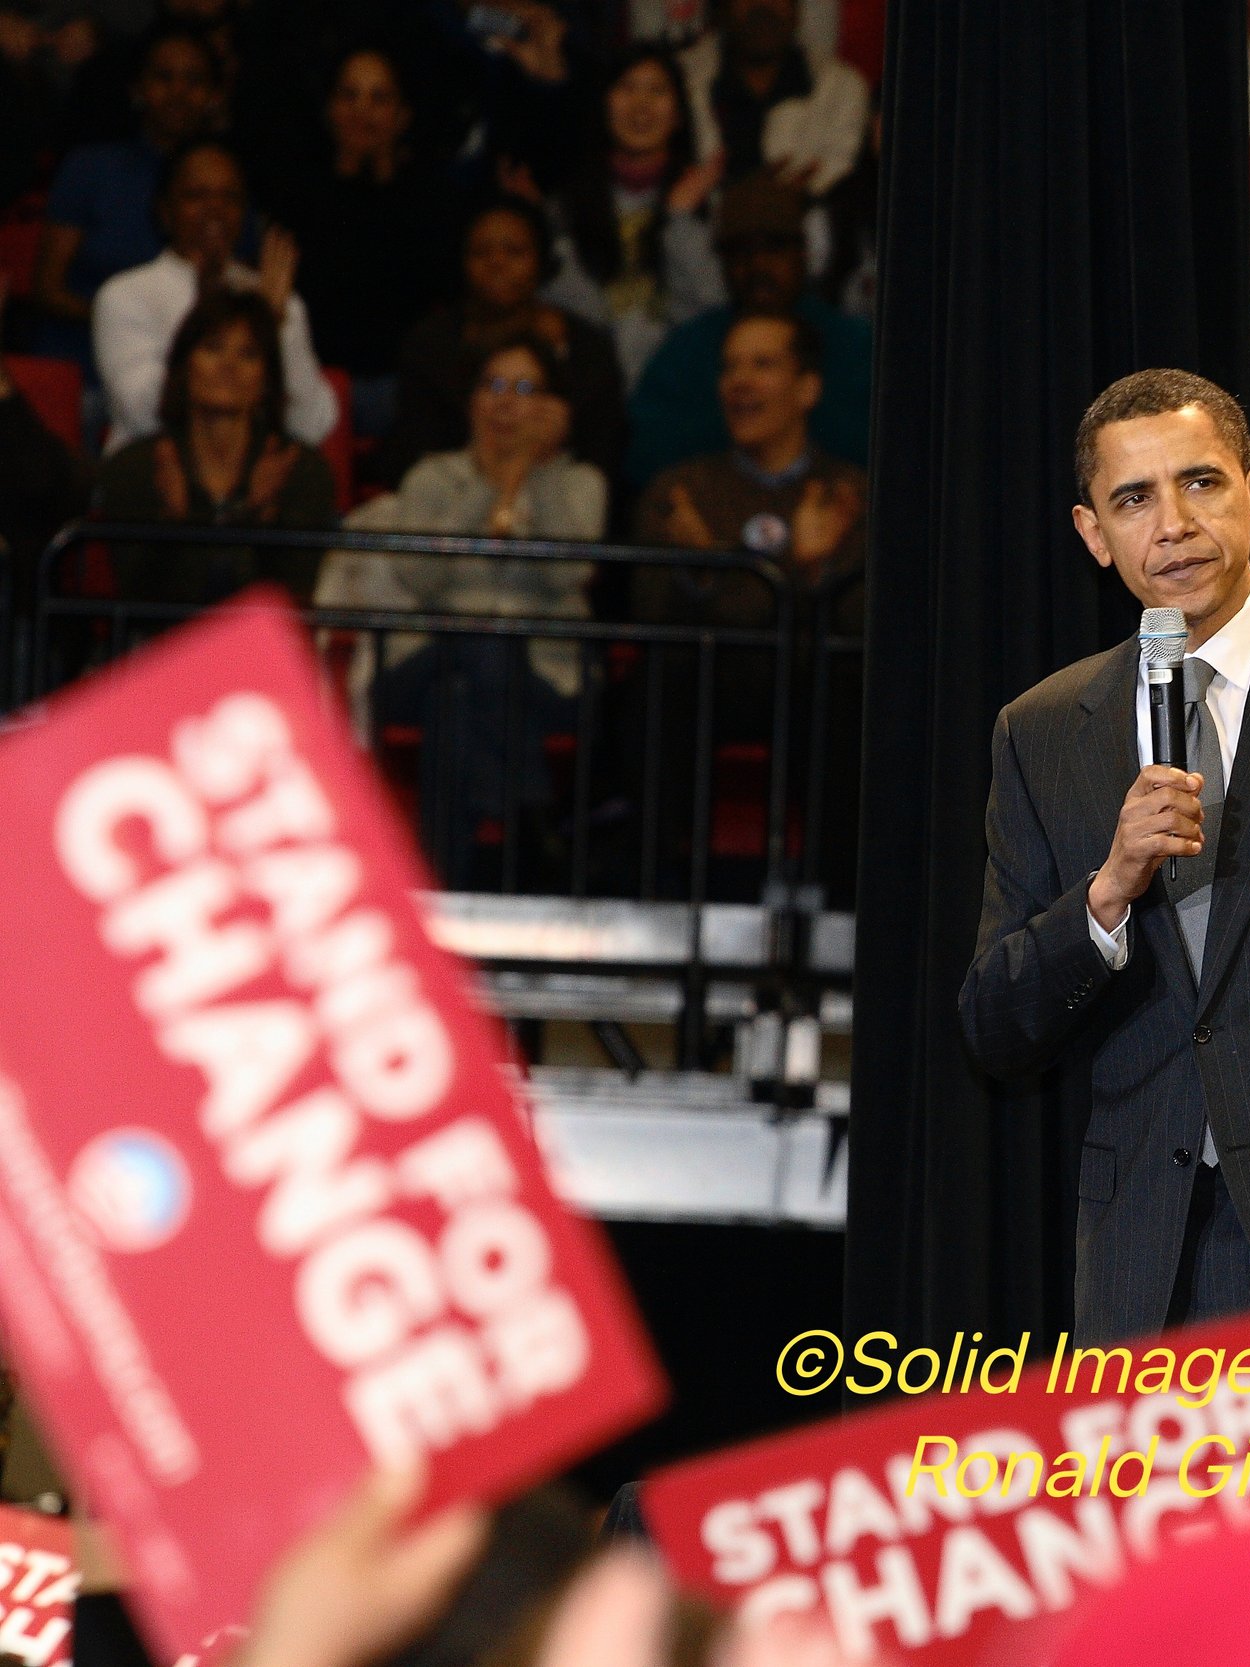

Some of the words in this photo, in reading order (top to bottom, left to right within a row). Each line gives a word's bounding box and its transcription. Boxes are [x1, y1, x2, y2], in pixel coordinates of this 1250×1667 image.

[54, 754, 500, 1510] CHANGE
[170, 692, 456, 1122] STAND
[394, 1114, 592, 1416] FOR
[702, 1428, 1045, 1586] STAND
